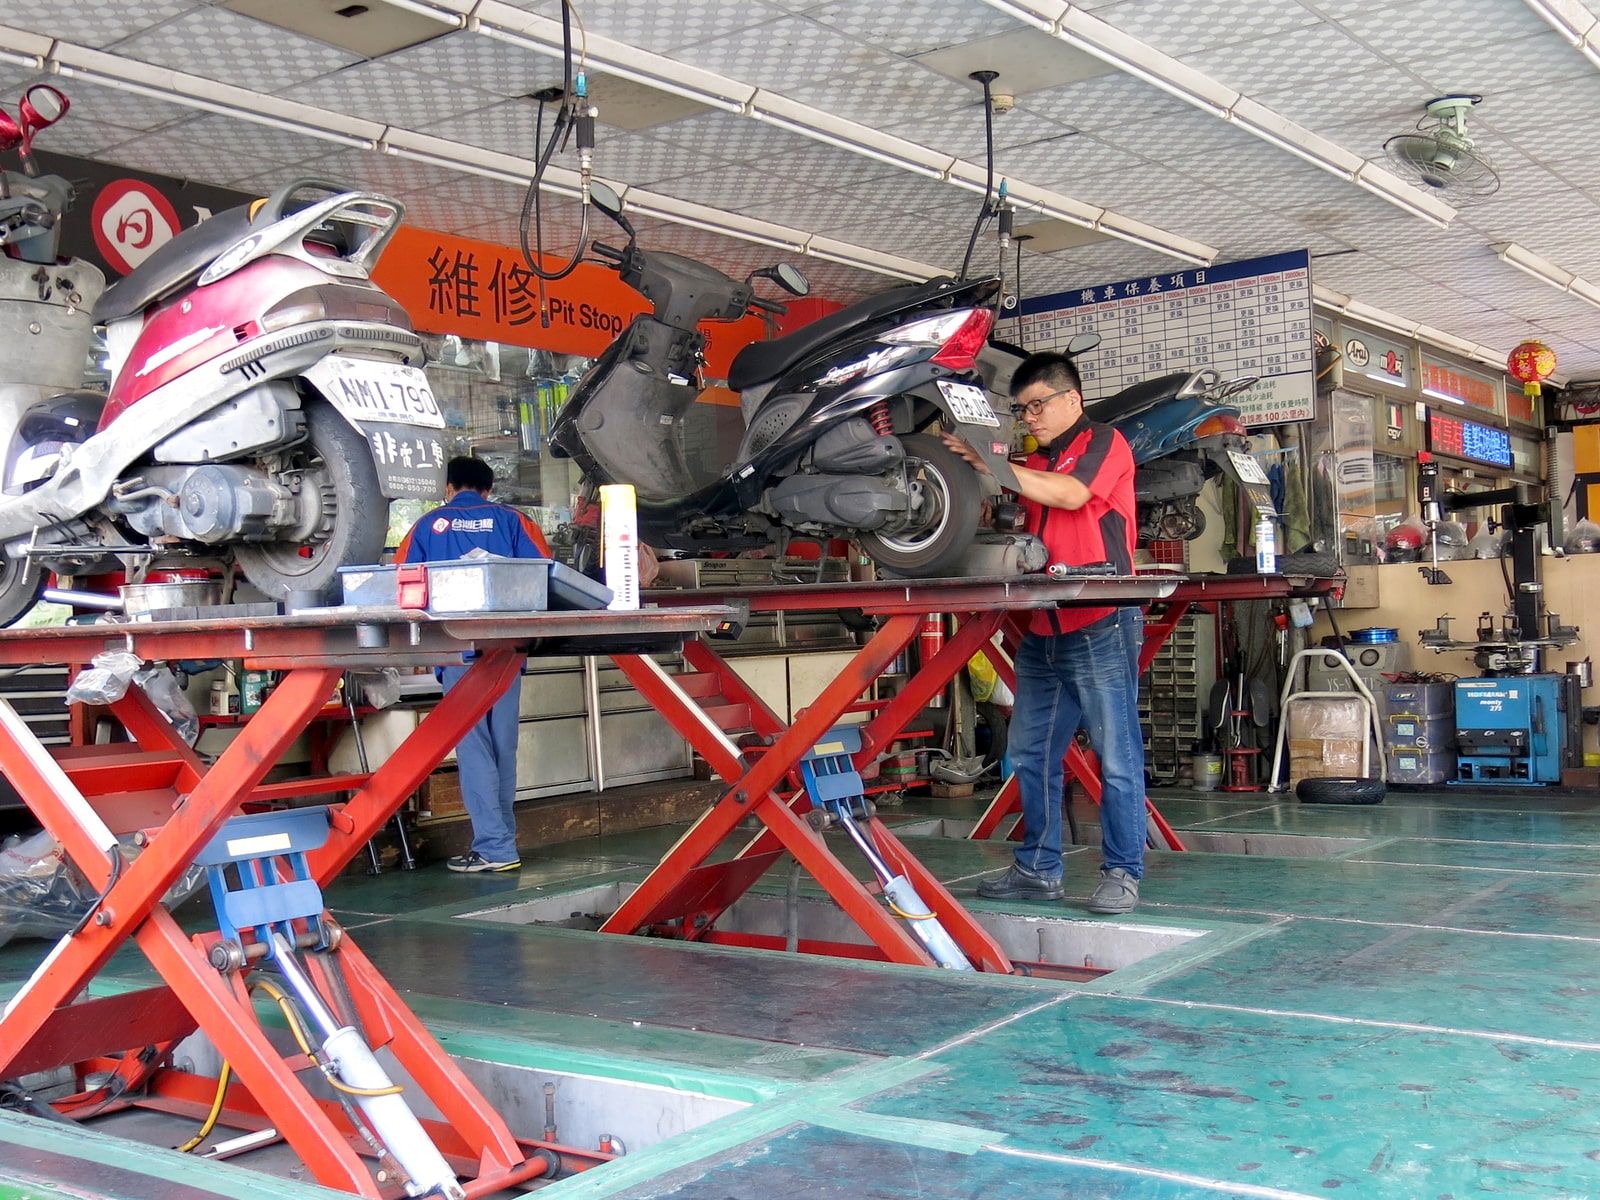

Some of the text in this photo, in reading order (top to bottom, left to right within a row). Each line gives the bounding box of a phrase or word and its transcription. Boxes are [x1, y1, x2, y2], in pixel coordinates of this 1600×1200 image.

[427, 246, 537, 326] 維修
[1080, 270, 1207, 303] 機車保養項目
[550, 297, 623, 338] Pit Stop
[1348, 342, 1367, 360] Arai
[1265, 412, 1280, 421] 100
[1387, 427, 1402, 440] agv
